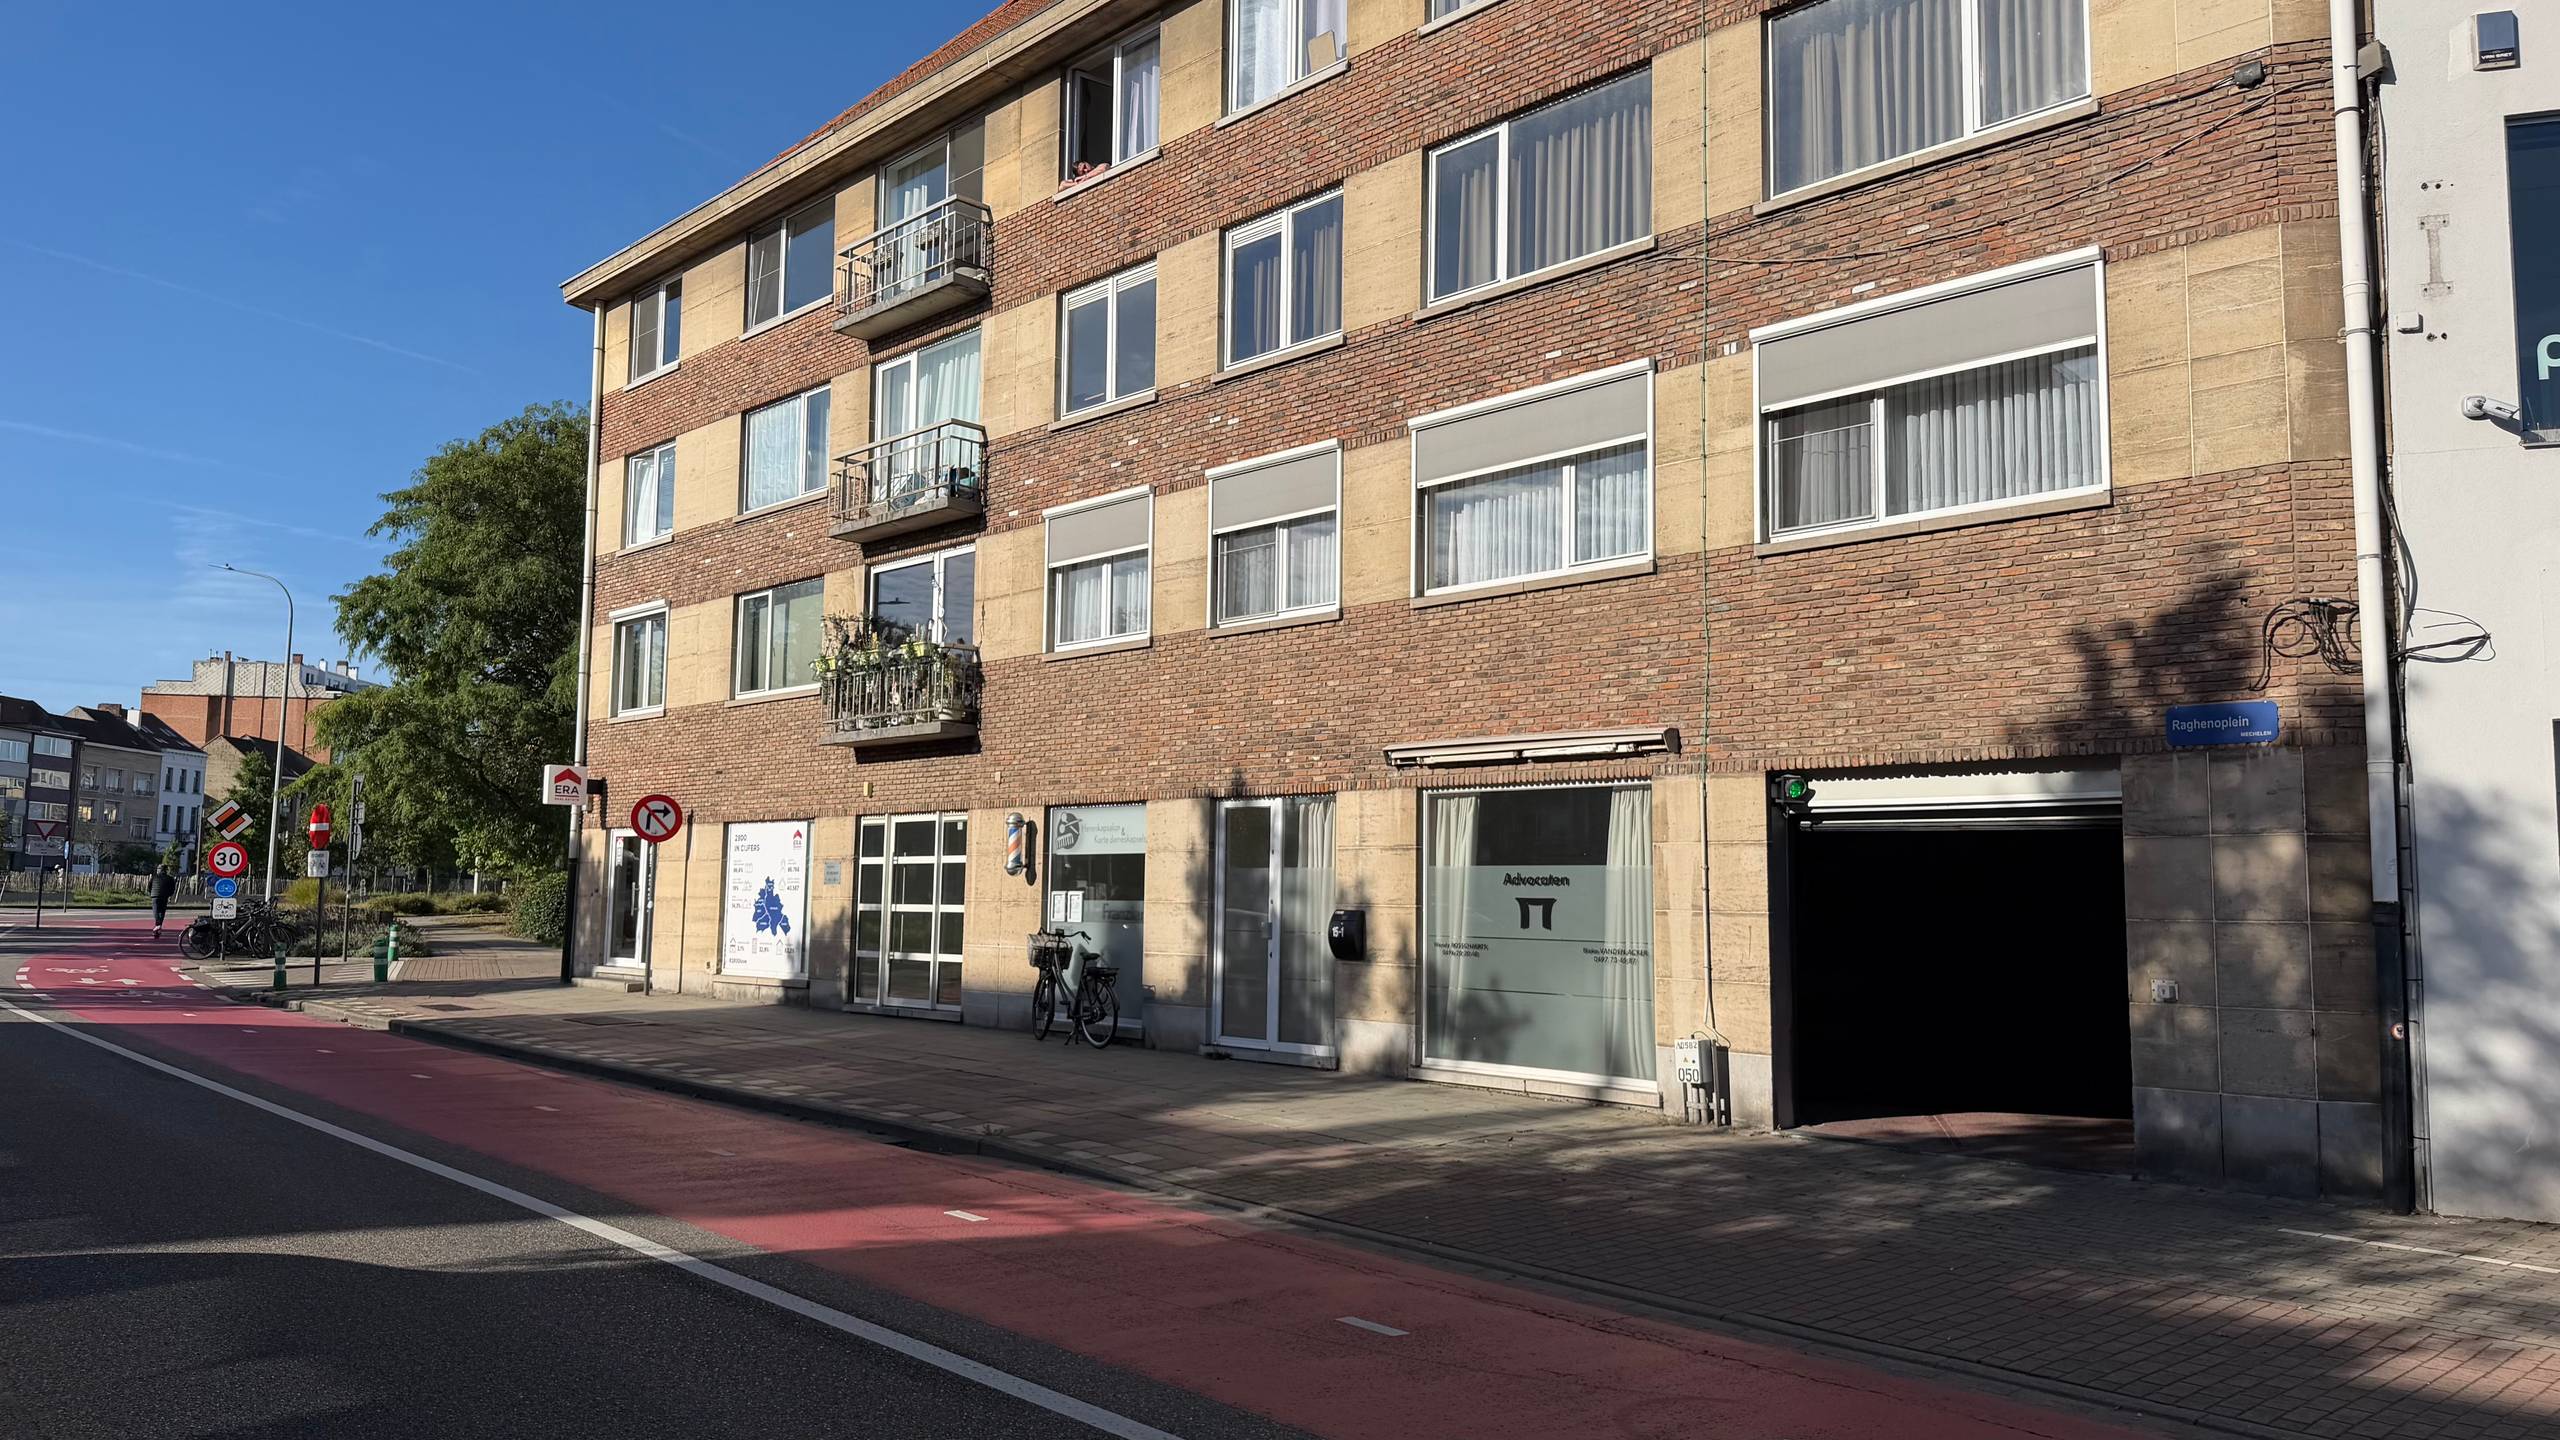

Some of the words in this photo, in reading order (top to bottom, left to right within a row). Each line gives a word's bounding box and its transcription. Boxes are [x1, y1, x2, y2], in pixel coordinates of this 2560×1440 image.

[2172, 716, 2249, 732] Raghenoplein
[555, 785, 579, 794] ERA
[216, 852, 240, 866] 30
[1503, 872, 1570, 887] Advocaten
[1678, 1067, 1700, 1083] 050
